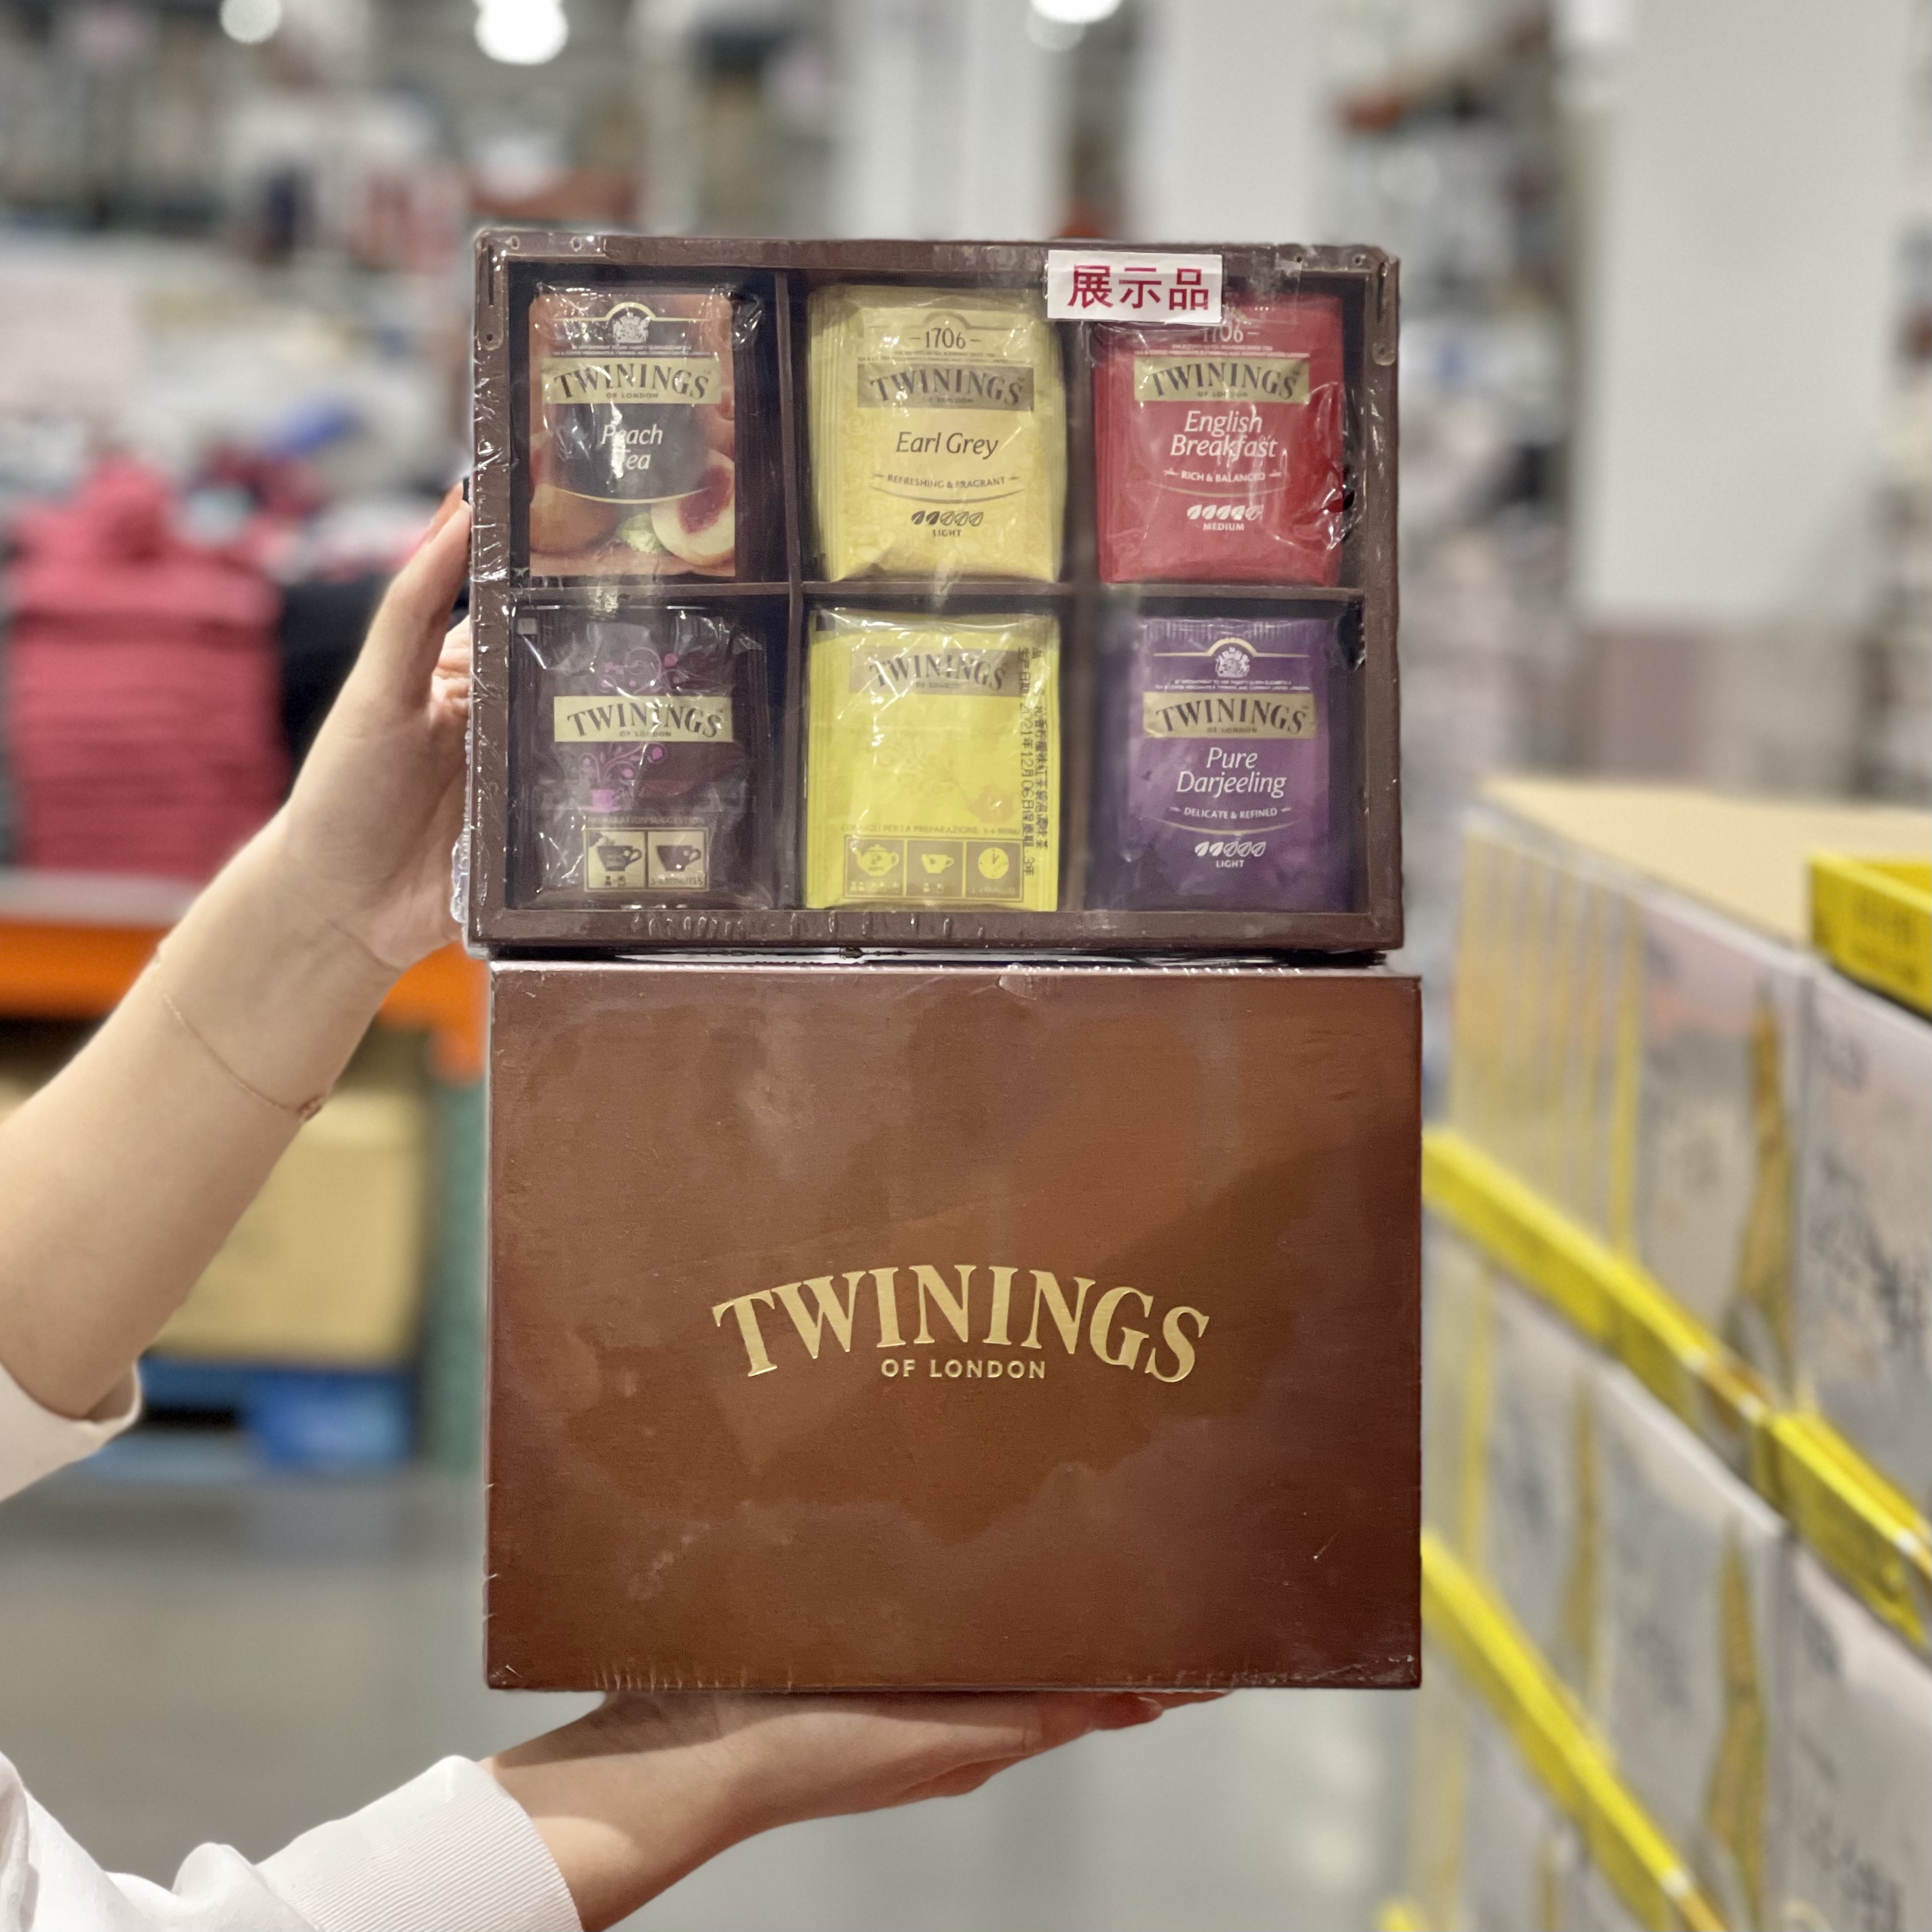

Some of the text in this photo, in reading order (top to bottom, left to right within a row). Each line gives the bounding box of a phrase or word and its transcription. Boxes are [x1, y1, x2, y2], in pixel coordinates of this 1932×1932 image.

[1068, 264, 1209, 311] 展示品
[926, 327, 966, 348] 1706
[554, 363, 709, 399] TWININGS
[869, 368, 1022, 405] TWININGS
[1148, 362, 1296, 399] TWININGS
[1184, 409, 1262, 437] English
[614, 449, 651, 470] ea
[896, 431, 998, 460] Earl Grey
[1170, 434, 1278, 462] Breakfast
[887, 474, 944, 488] REFRESHING
[955, 476, 1006, 488] FRAGRANT
[1181, 470, 1204, 481] RICH
[932, 529, 962, 537] LIGHT
[1203, 522, 1245, 531] MEDIUM
[869, 654, 1006, 691] TWININGS
[1156, 699, 1307, 735] TWININGS
[1206, 747, 1258, 769] Pure
[1176, 771, 1287, 799] Darjeeling
[1184, 807, 1228, 819] DELICATE
[1239, 807, 1277, 819] REFINED
[1216, 860, 1245, 868] LIGHT
[712, 1264, 1209, 1383] TWININGS
[881, 1359, 1046, 1379] OF LONDON
